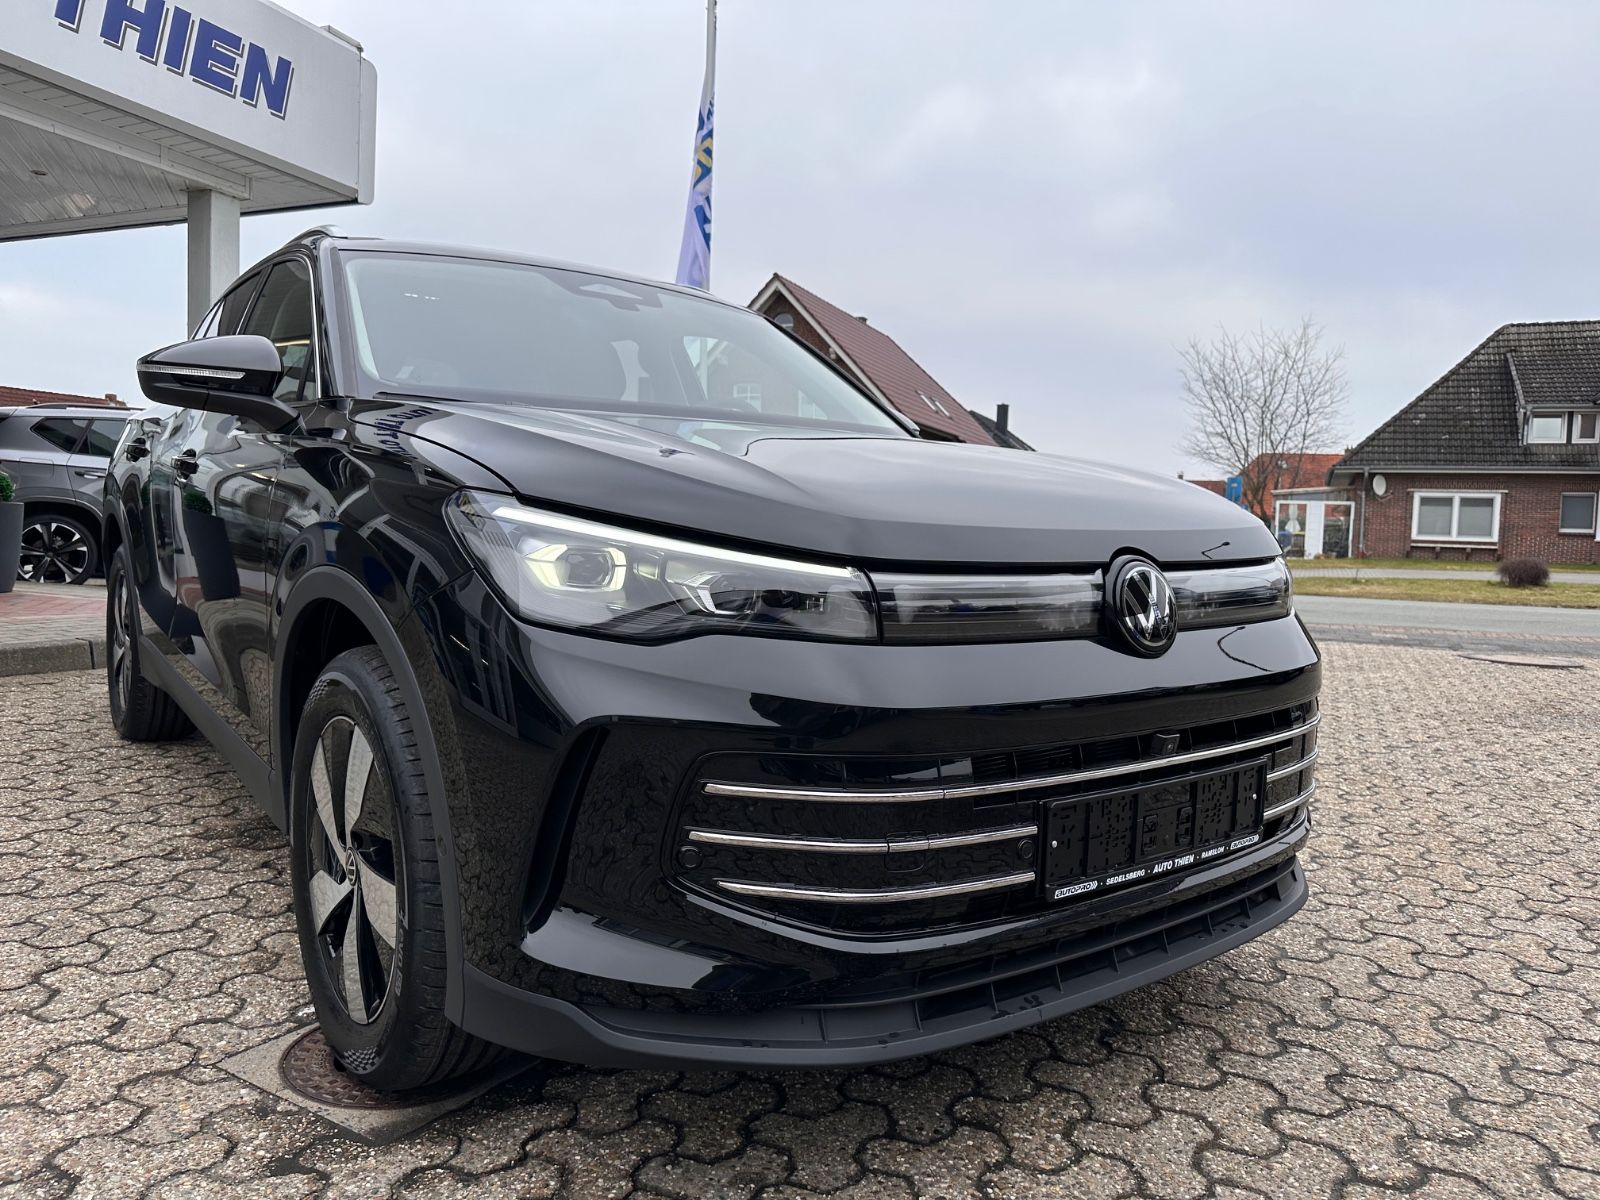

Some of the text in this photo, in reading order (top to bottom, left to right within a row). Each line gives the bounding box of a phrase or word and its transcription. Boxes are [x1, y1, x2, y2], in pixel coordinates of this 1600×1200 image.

[1105, 869, 1146, 885] SEDELSBERG
[1152, 860, 1173, 874] AUTO
[1174, 854, 1195, 868] THIEN
